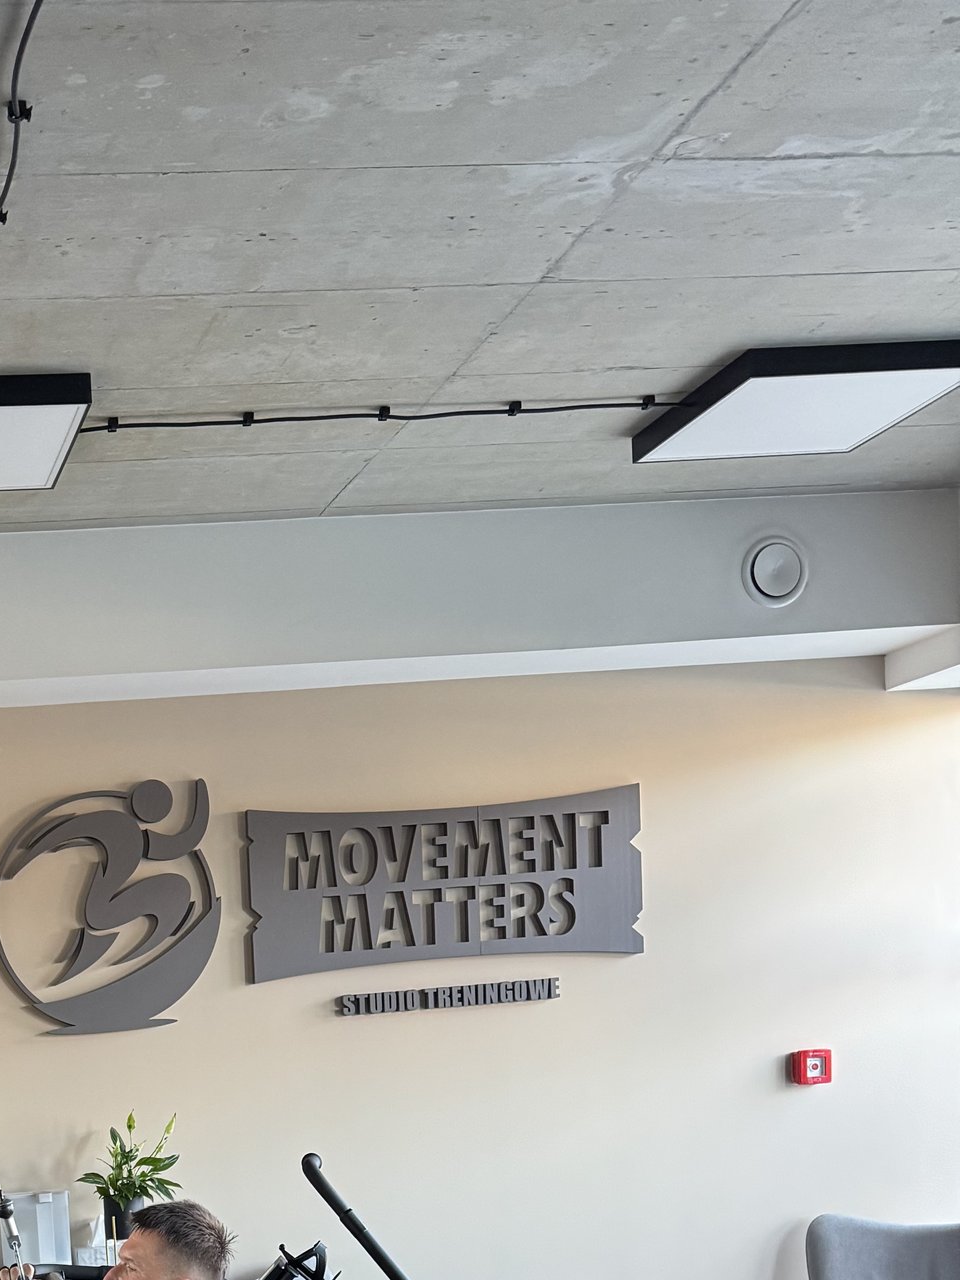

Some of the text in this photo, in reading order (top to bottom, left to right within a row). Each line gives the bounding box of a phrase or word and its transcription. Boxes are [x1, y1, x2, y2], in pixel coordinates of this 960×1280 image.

[283, 810, 610, 890] MOVEMENT
[319, 877, 577, 953] MATTERS
[338, 977, 560, 1017] STUDIO TRENINGOWE
